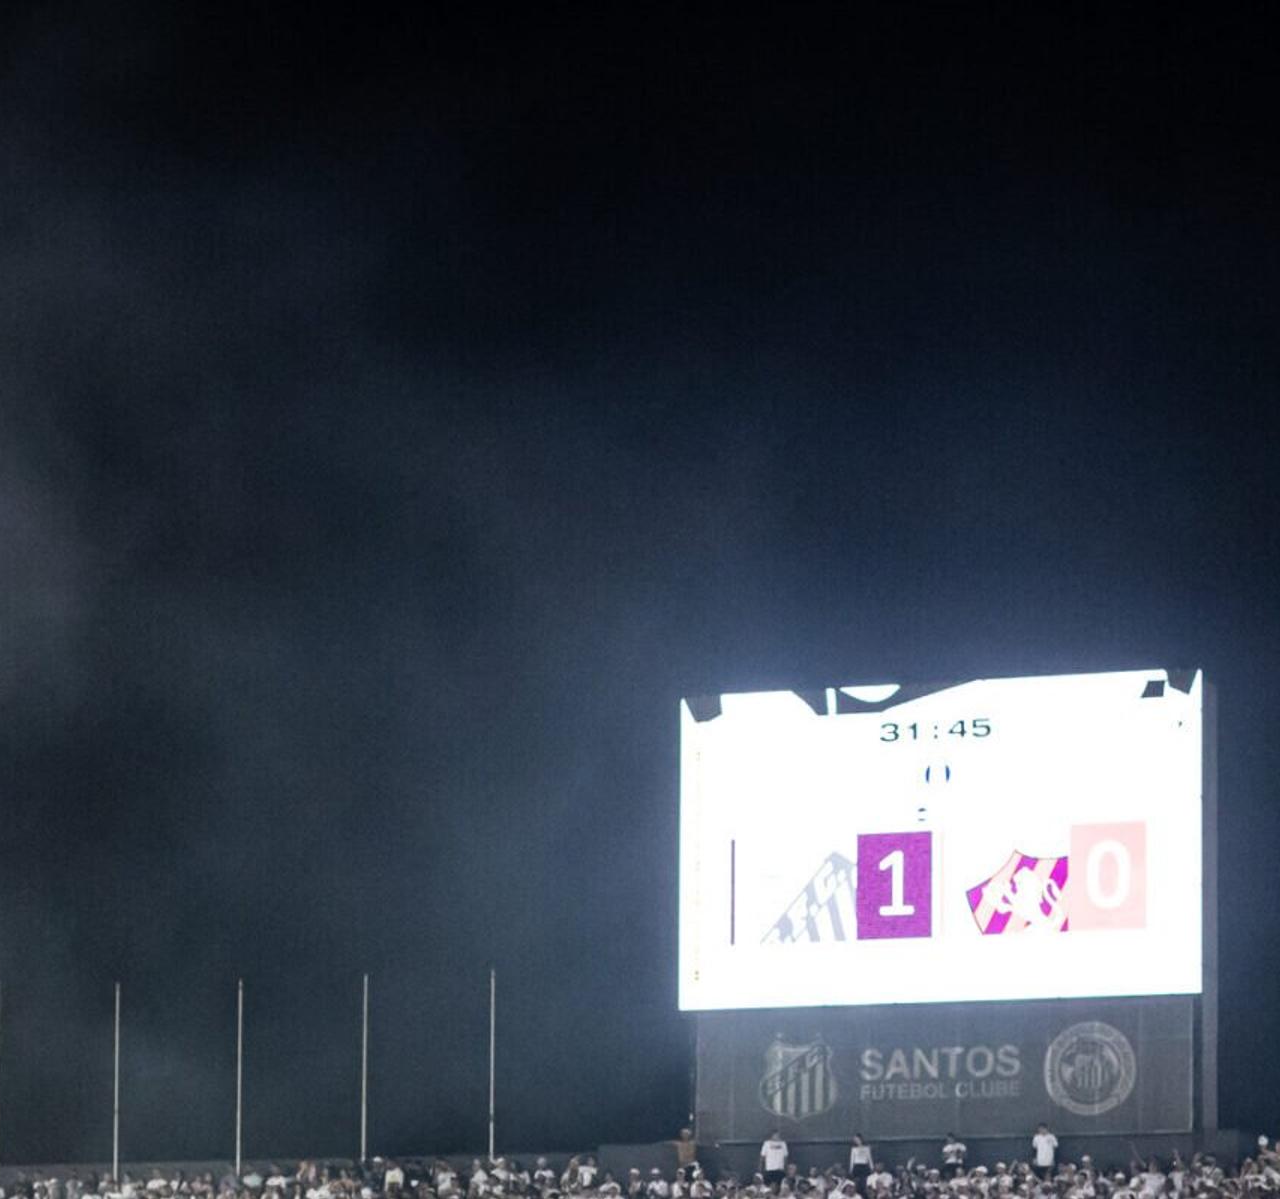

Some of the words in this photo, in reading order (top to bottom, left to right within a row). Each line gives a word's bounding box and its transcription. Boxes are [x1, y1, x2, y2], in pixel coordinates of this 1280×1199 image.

[880, 718, 992, 742] 31:45
[879, 850, 915, 917] 1
[1085, 840, 1130, 910] 0
[860, 1045, 1020, 1081] SANTOS
[860, 1082, 948, 1101] FUTEBOL
[955, 1079, 1020, 1099] CLUBE
